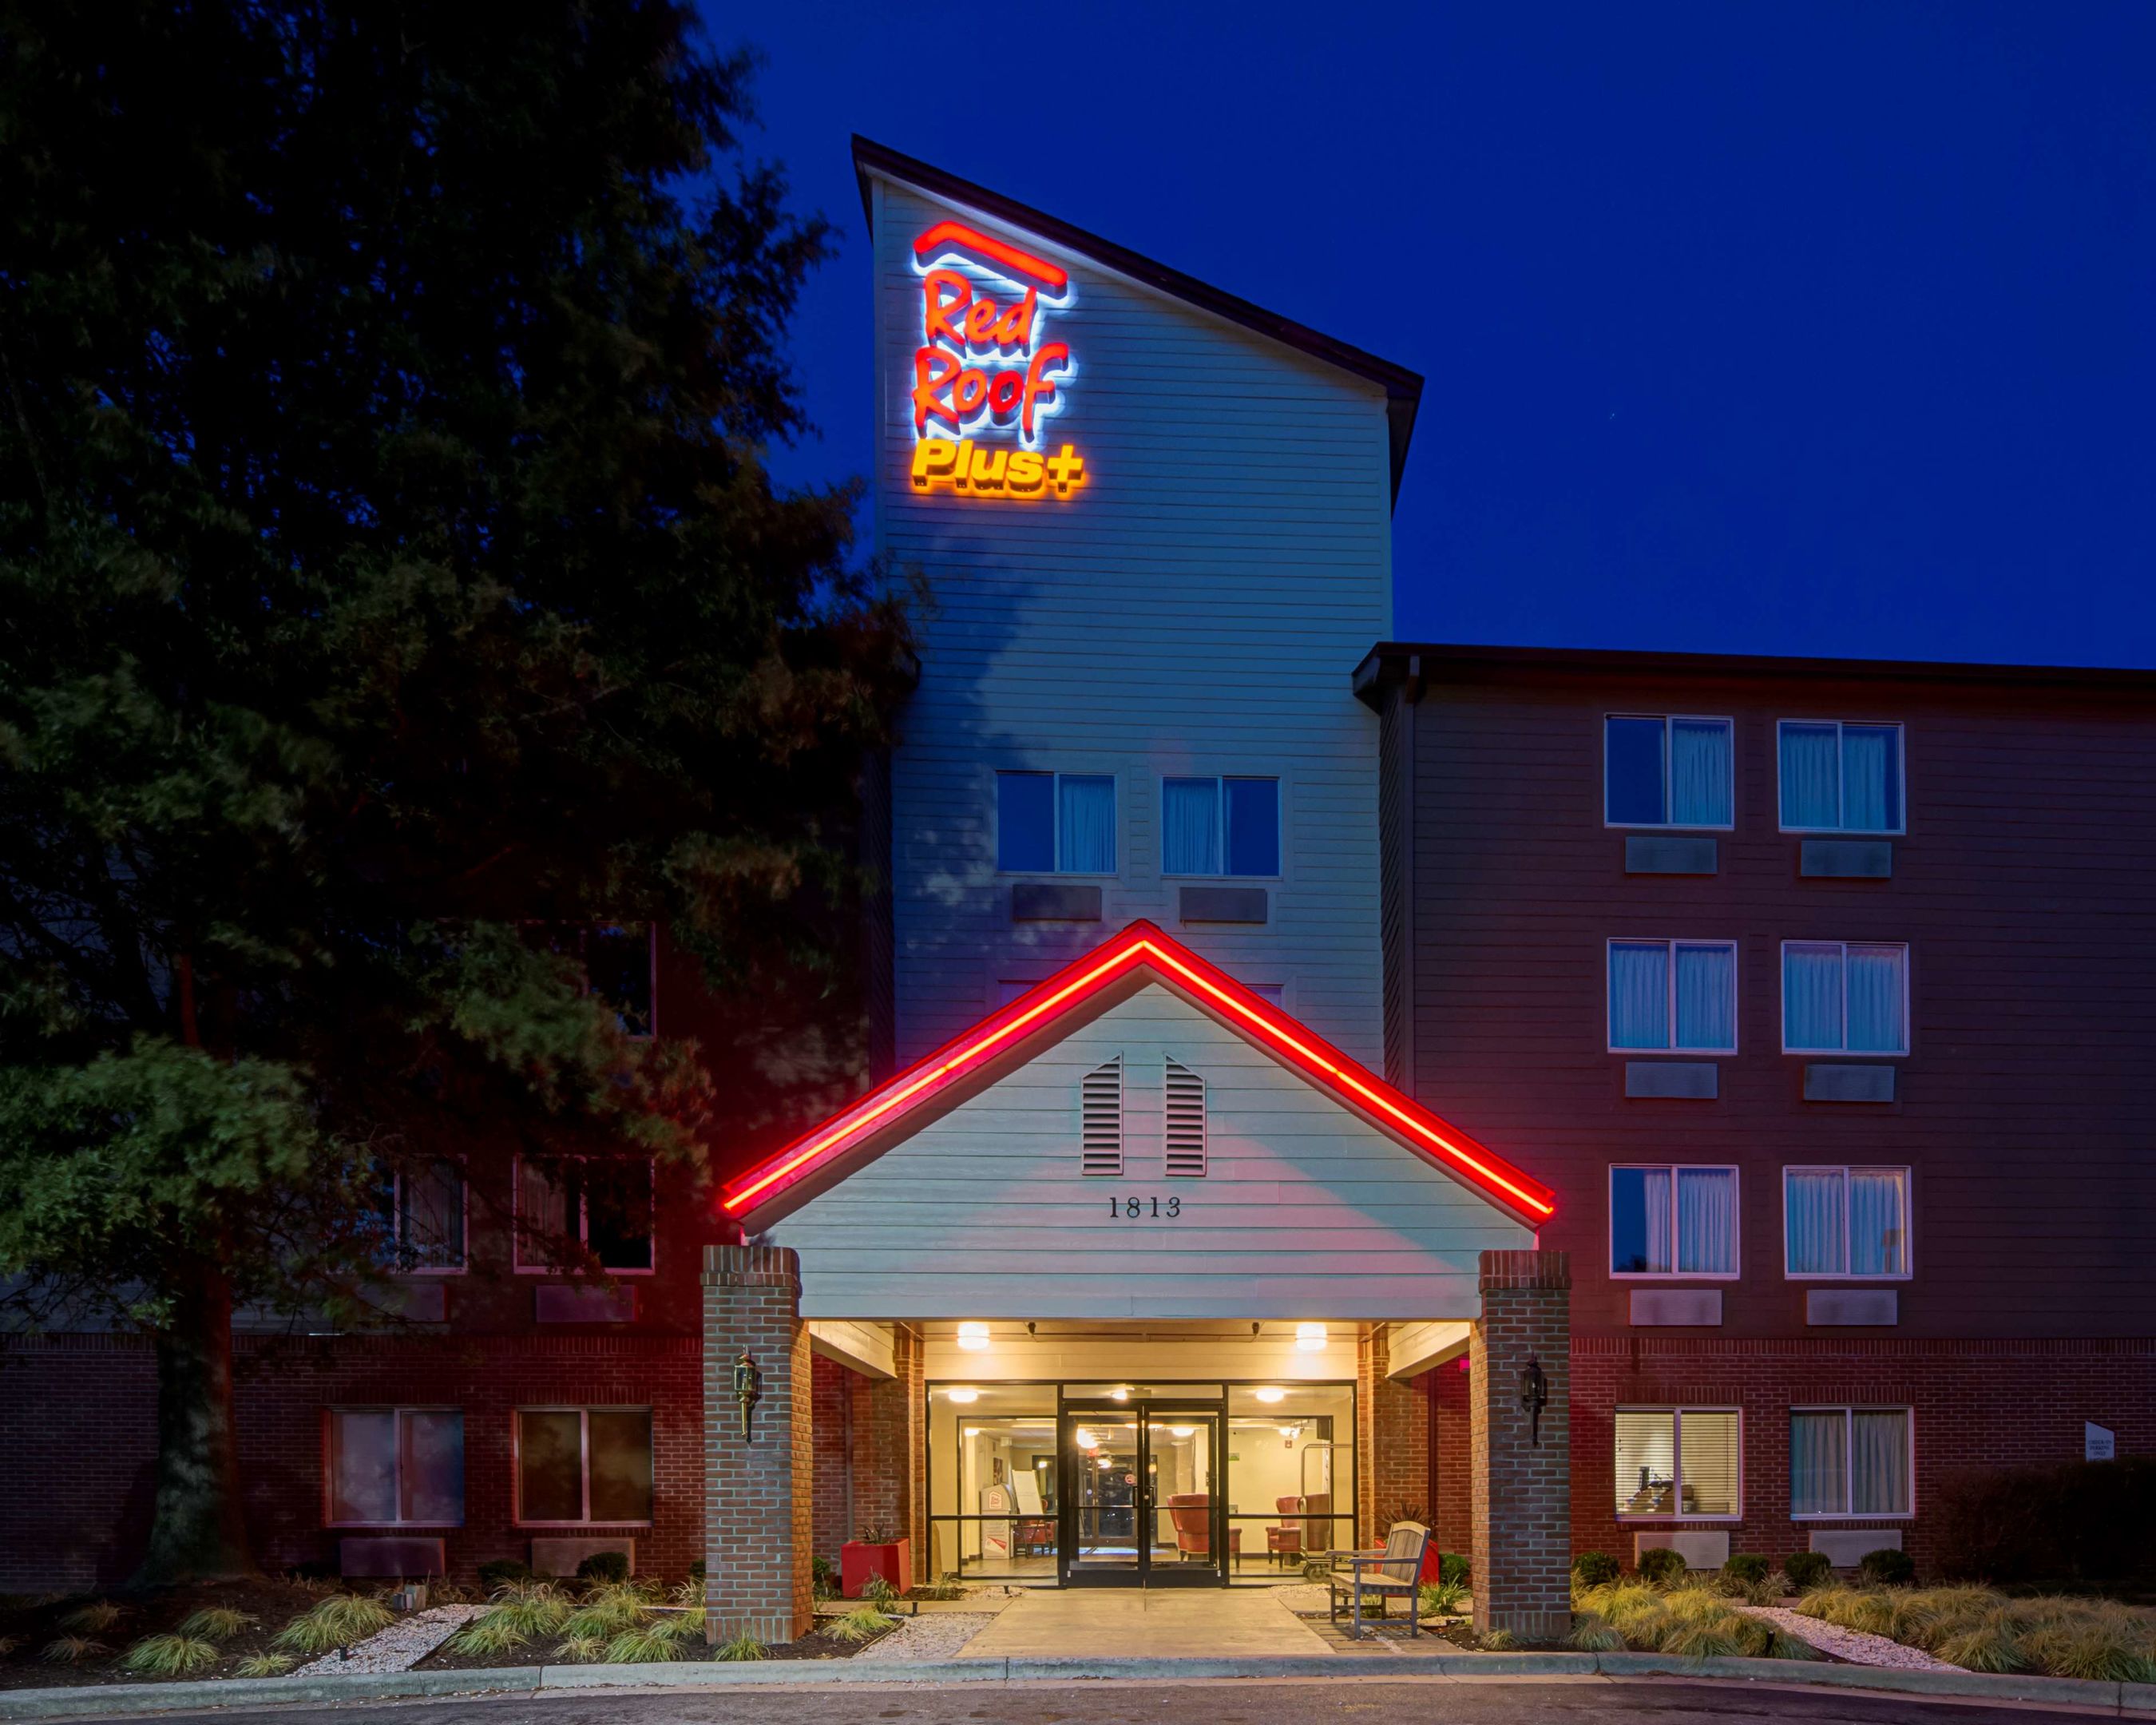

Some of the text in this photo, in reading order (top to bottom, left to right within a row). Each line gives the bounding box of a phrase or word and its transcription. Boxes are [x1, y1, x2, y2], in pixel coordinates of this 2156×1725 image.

[924, 269, 1037, 346] Red
[912, 343, 1069, 433] Roof
[911, 438, 1084, 484] Plus+
[1109, 1196, 1181, 1219] 1813
